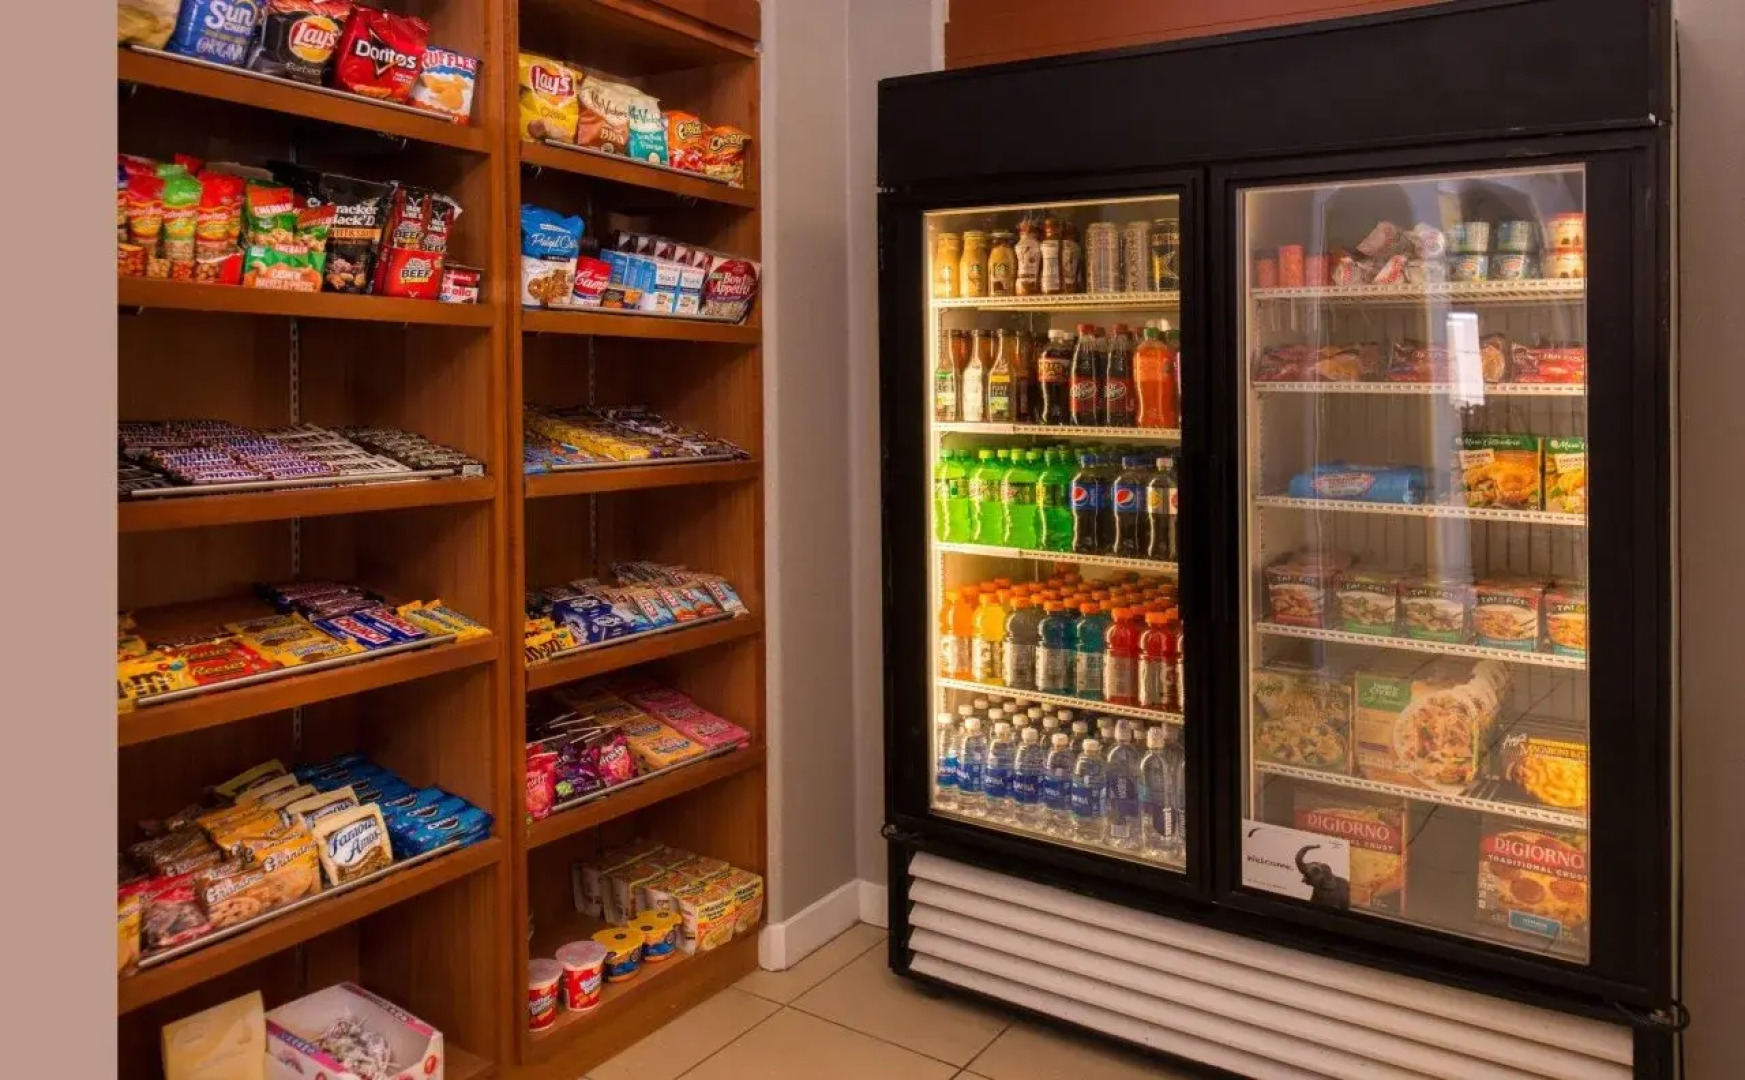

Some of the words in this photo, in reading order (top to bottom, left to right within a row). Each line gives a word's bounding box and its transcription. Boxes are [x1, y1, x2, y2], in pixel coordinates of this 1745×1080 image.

[204, 0, 253, 29] Sun
[355, 40, 417, 69] Doritos
[535, 67, 571, 95] Lay's
[328, 816, 377, 858] Famous
[1307, 812, 1389, 842] DIGIORNO
[1487, 853, 1554, 873] TRADITIONAL
[1493, 836, 1584, 869] DIGIORNO
